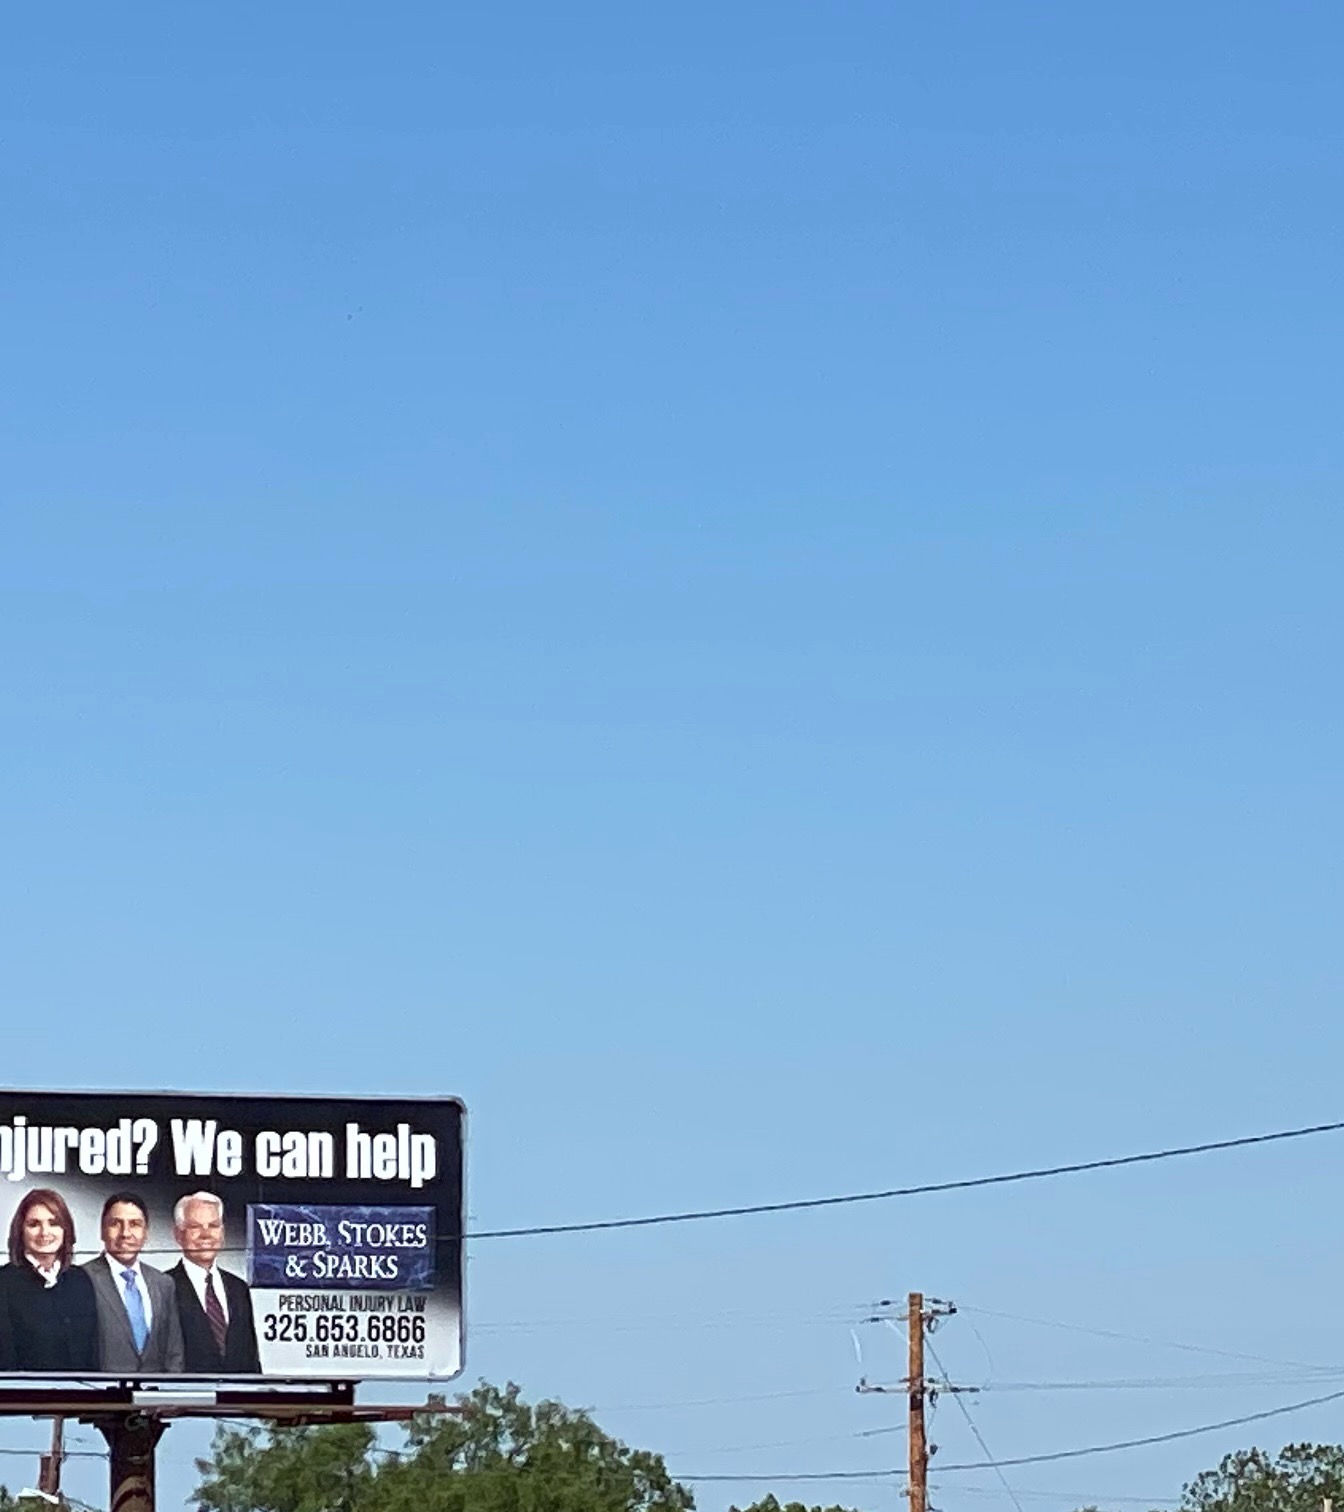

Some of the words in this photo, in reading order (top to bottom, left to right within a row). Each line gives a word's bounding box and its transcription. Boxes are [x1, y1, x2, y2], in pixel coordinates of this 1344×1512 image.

[170, 1118, 243, 1177] We
[255, 1130, 333, 1178] can
[345, 1122, 437, 1188] help
[257, 1218, 331, 1250] WEBB,
[338, 1220, 427, 1248] STOKES
[285, 1253, 308, 1279] &
[313, 1251, 398, 1279] SPARKS
[278, 1294, 346, 1312] PERSONAL
[350, 1294, 394, 1312] INJURY
[399, 1294, 427, 1312] LAW
[263, 1313, 426, 1343] 325.653.6866
[305, 1344, 329, 1359] SAN
[387, 1344, 425, 1360] TEXAS
